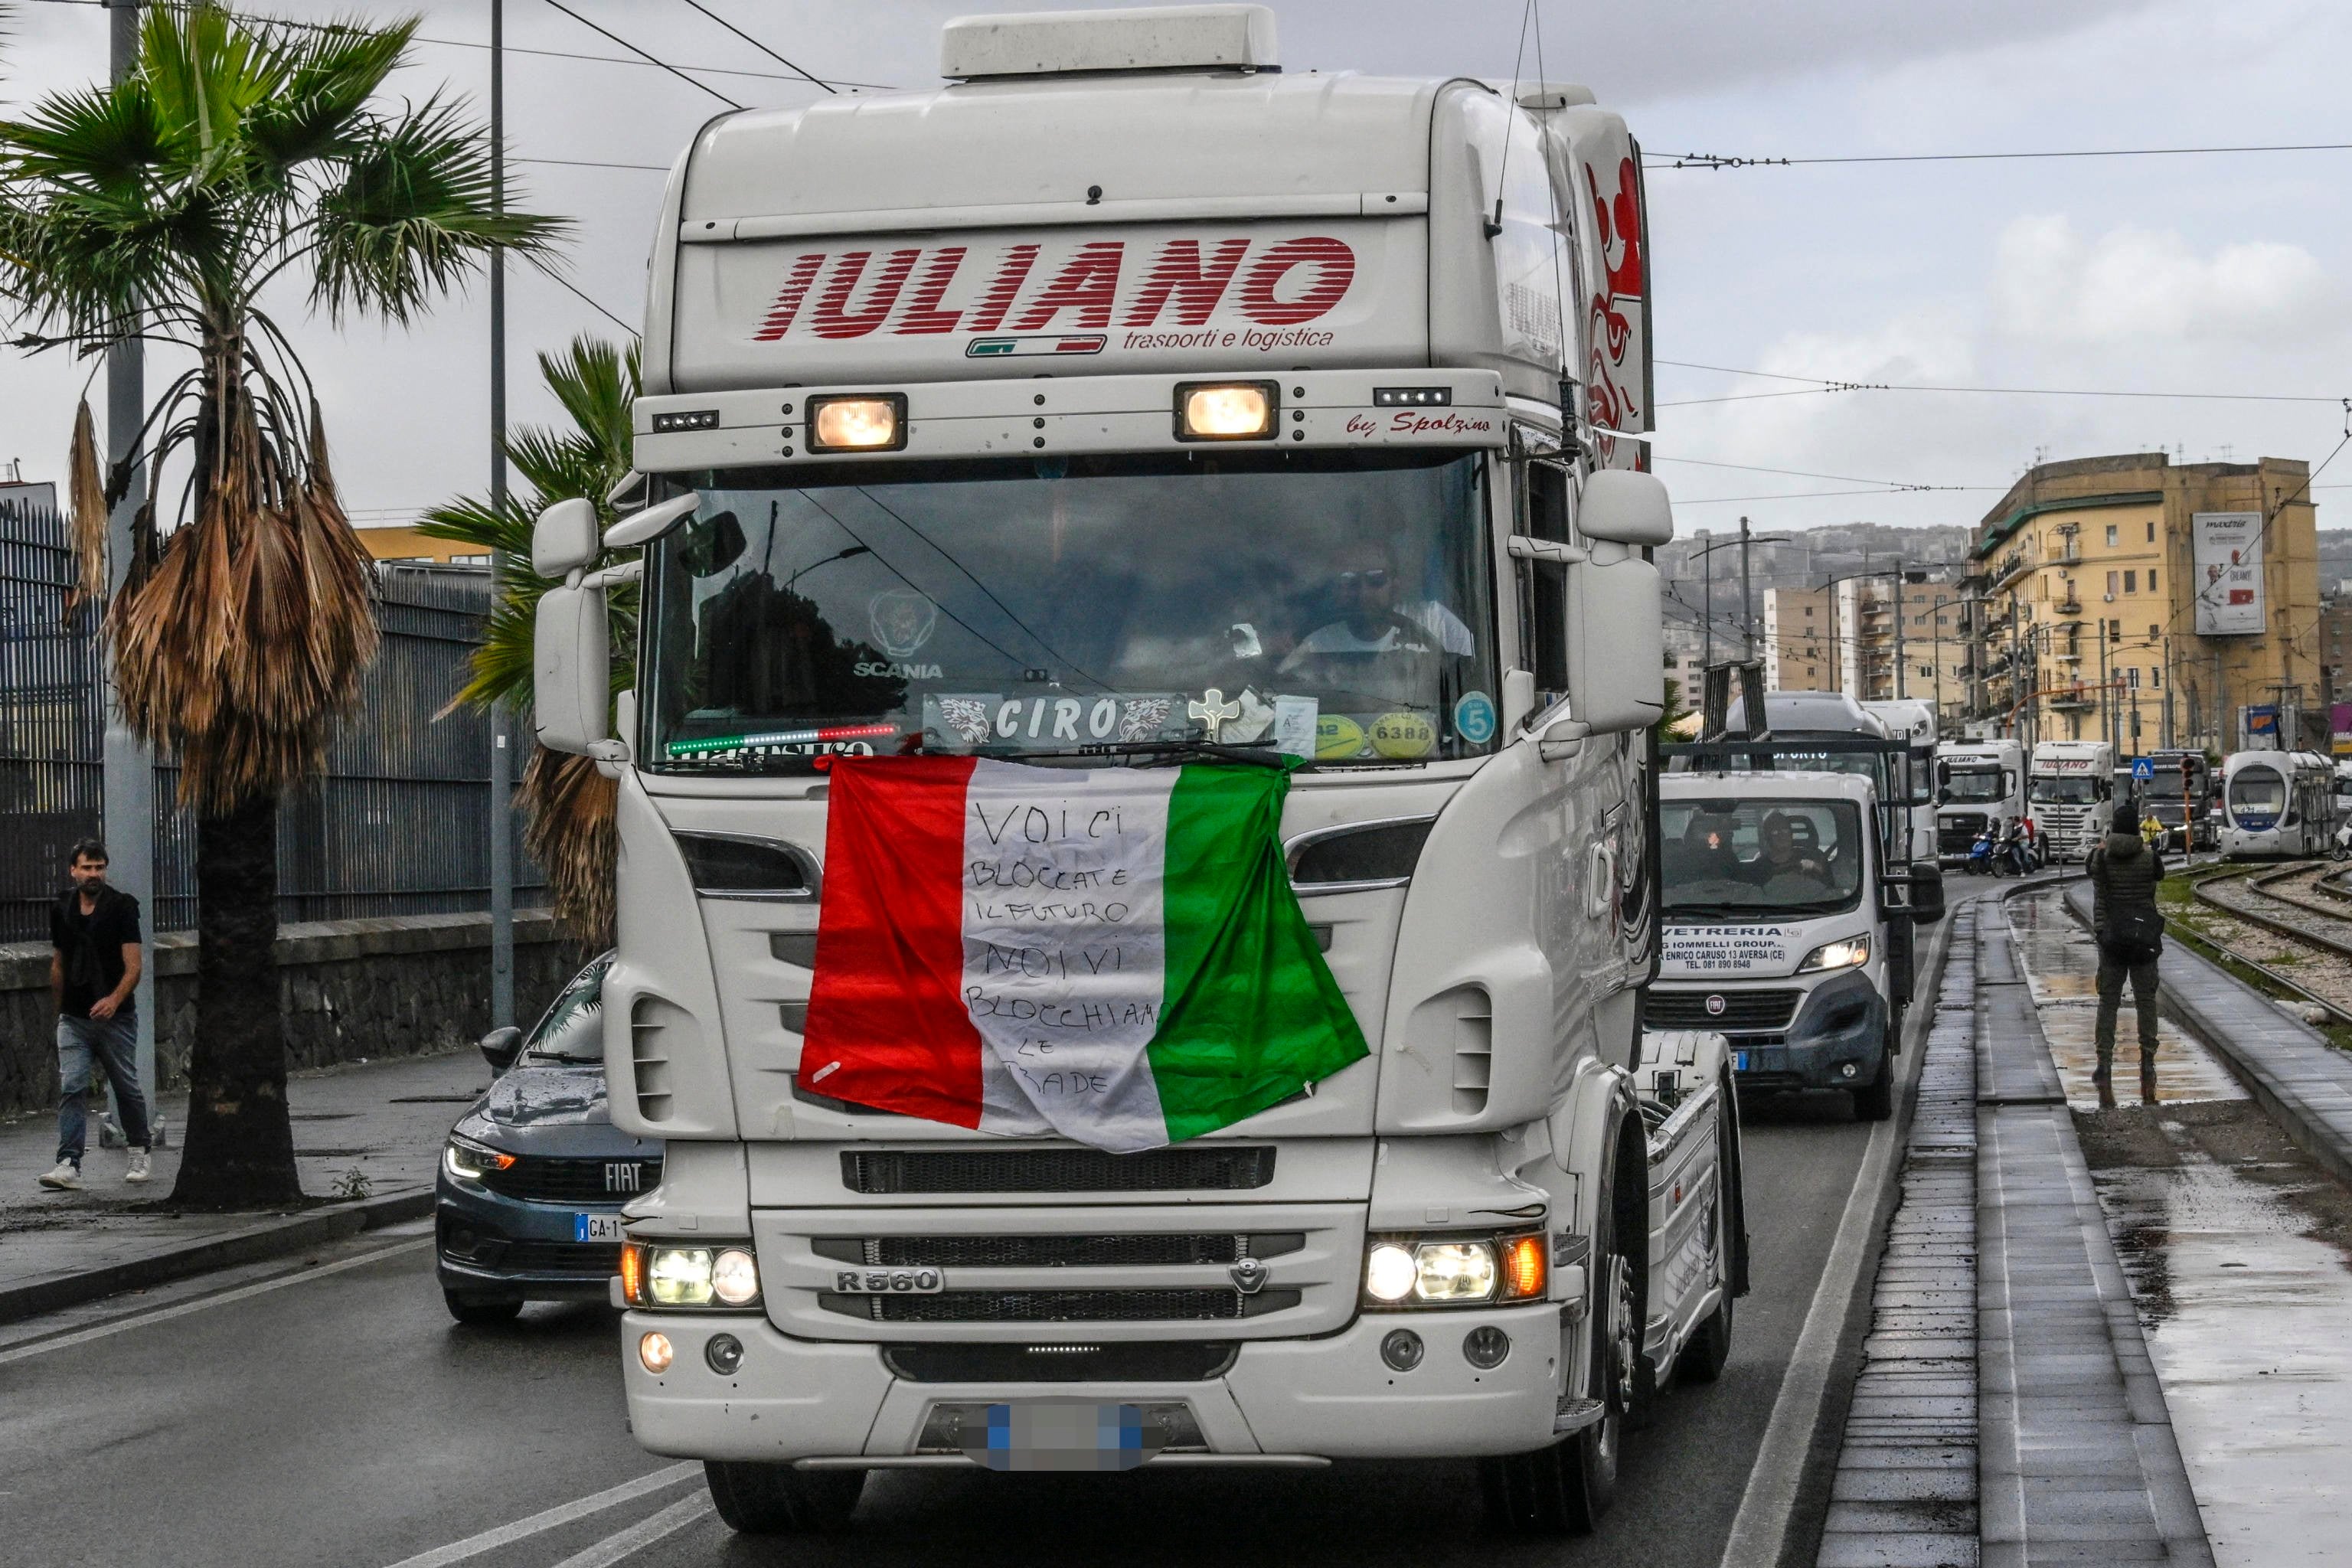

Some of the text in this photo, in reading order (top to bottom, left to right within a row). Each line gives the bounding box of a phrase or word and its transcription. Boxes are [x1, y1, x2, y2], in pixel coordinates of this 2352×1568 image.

[747, 237, 1356, 341] IULIANO
[1123, 328, 1334, 351] trasporti e logistica
[1347, 412, 1491, 437] by Spolzino
[854, 662, 943, 679] SCANIA
[996, 698, 1116, 741] CIRO
[1469, 709, 1488, 736] 5
[971, 861, 1128, 890] BLOCCATE
[1004, 902, 1129, 923] FUTURO
[1662, 928, 1782, 936] VETRERIA
[987, 943, 1066, 980] NOI
[1666, 951, 1694, 961] ENRICO
[1696, 950, 1726, 960] CARUSO
[1729, 950, 1736, 959] 13
[1739, 950, 1768, 959] AVERSA
[1770, 950, 1785, 962] (CE)
[1703, 960, 1715, 969] 081
[1718, 960, 1731, 969] 890
[1733, 960, 1751, 969] 8948
[1018, 1037, 1054, 1057] LE
[606, 1163, 642, 1191] FIAT
